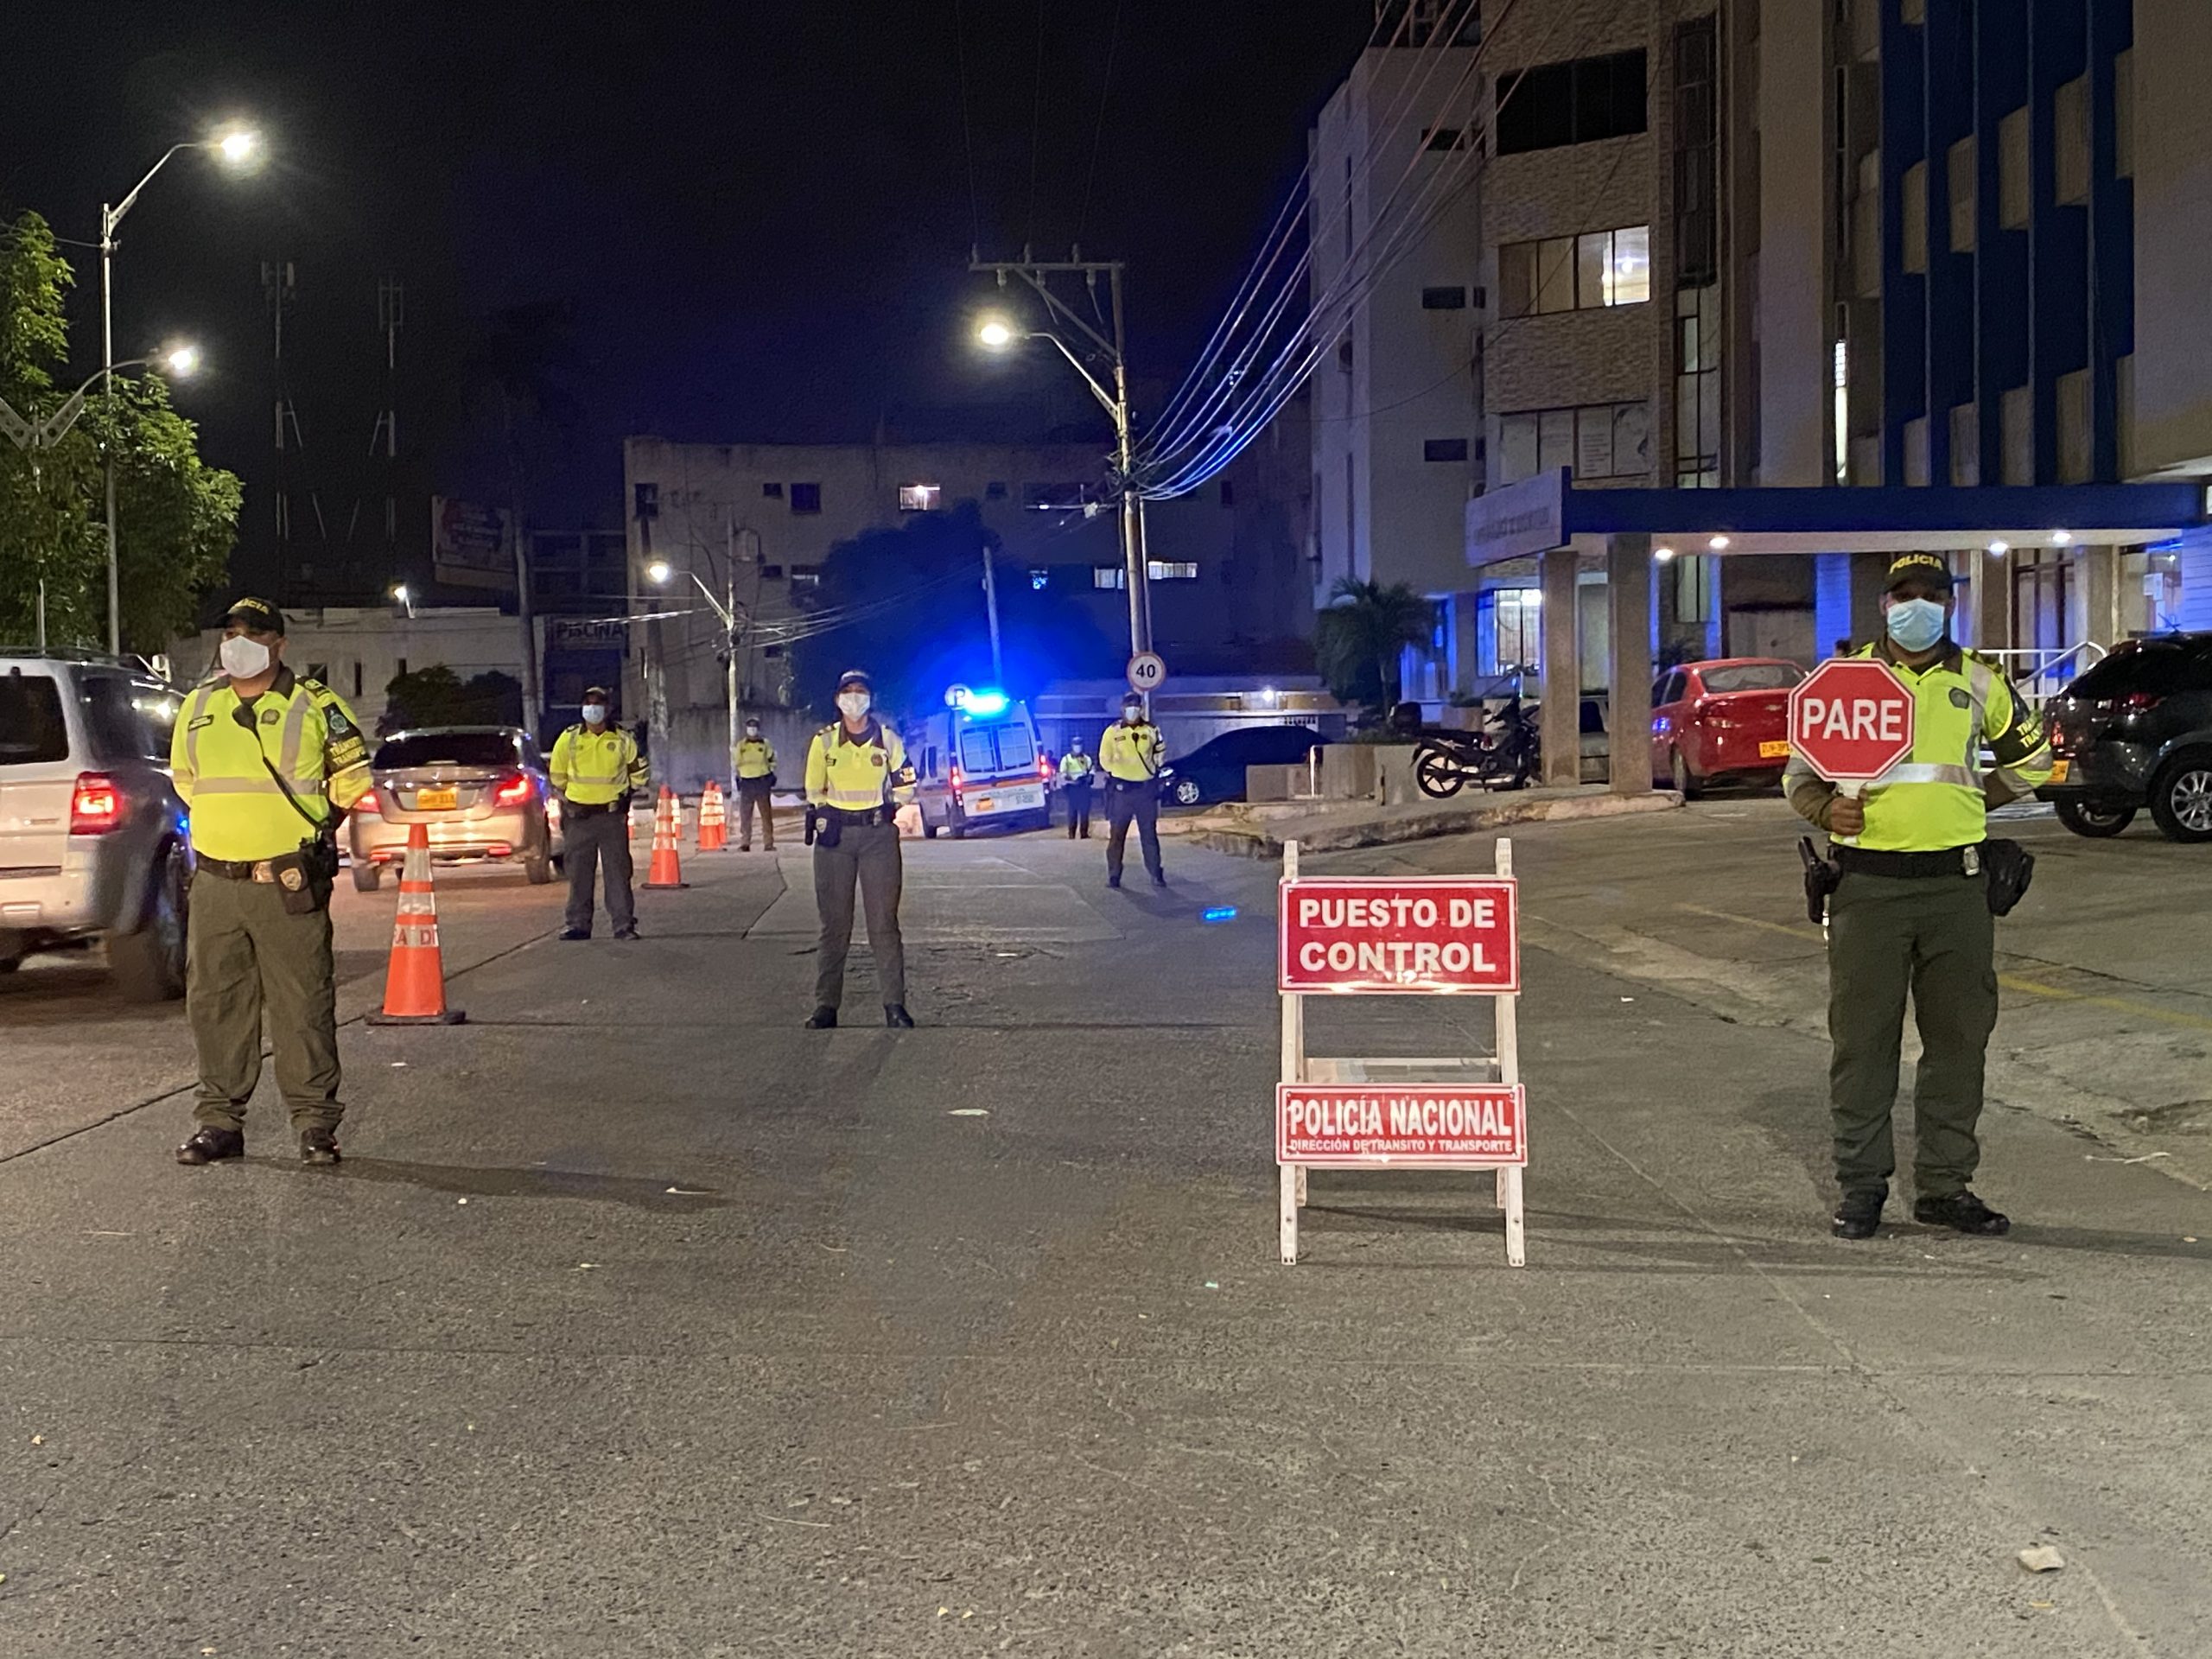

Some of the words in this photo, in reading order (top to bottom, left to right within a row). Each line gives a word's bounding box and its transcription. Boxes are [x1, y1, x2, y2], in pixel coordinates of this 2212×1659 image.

[1889, 554, 1943, 574] POLICIA
[1135, 664, 1156, 678] 40
[1802, 697, 1904, 741] PARE
[1299, 898, 1438, 928] PUESTO
[1449, 899, 1496, 928] DE
[1299, 941, 1497, 973] CONTROL
[1389, 1098, 1512, 1136] NACIONAL
[1352, 1139, 1368, 1152] DE
[1427, 1140, 1436, 1152] Y
[1438, 1140, 1512, 1153] TRANSPORTE
